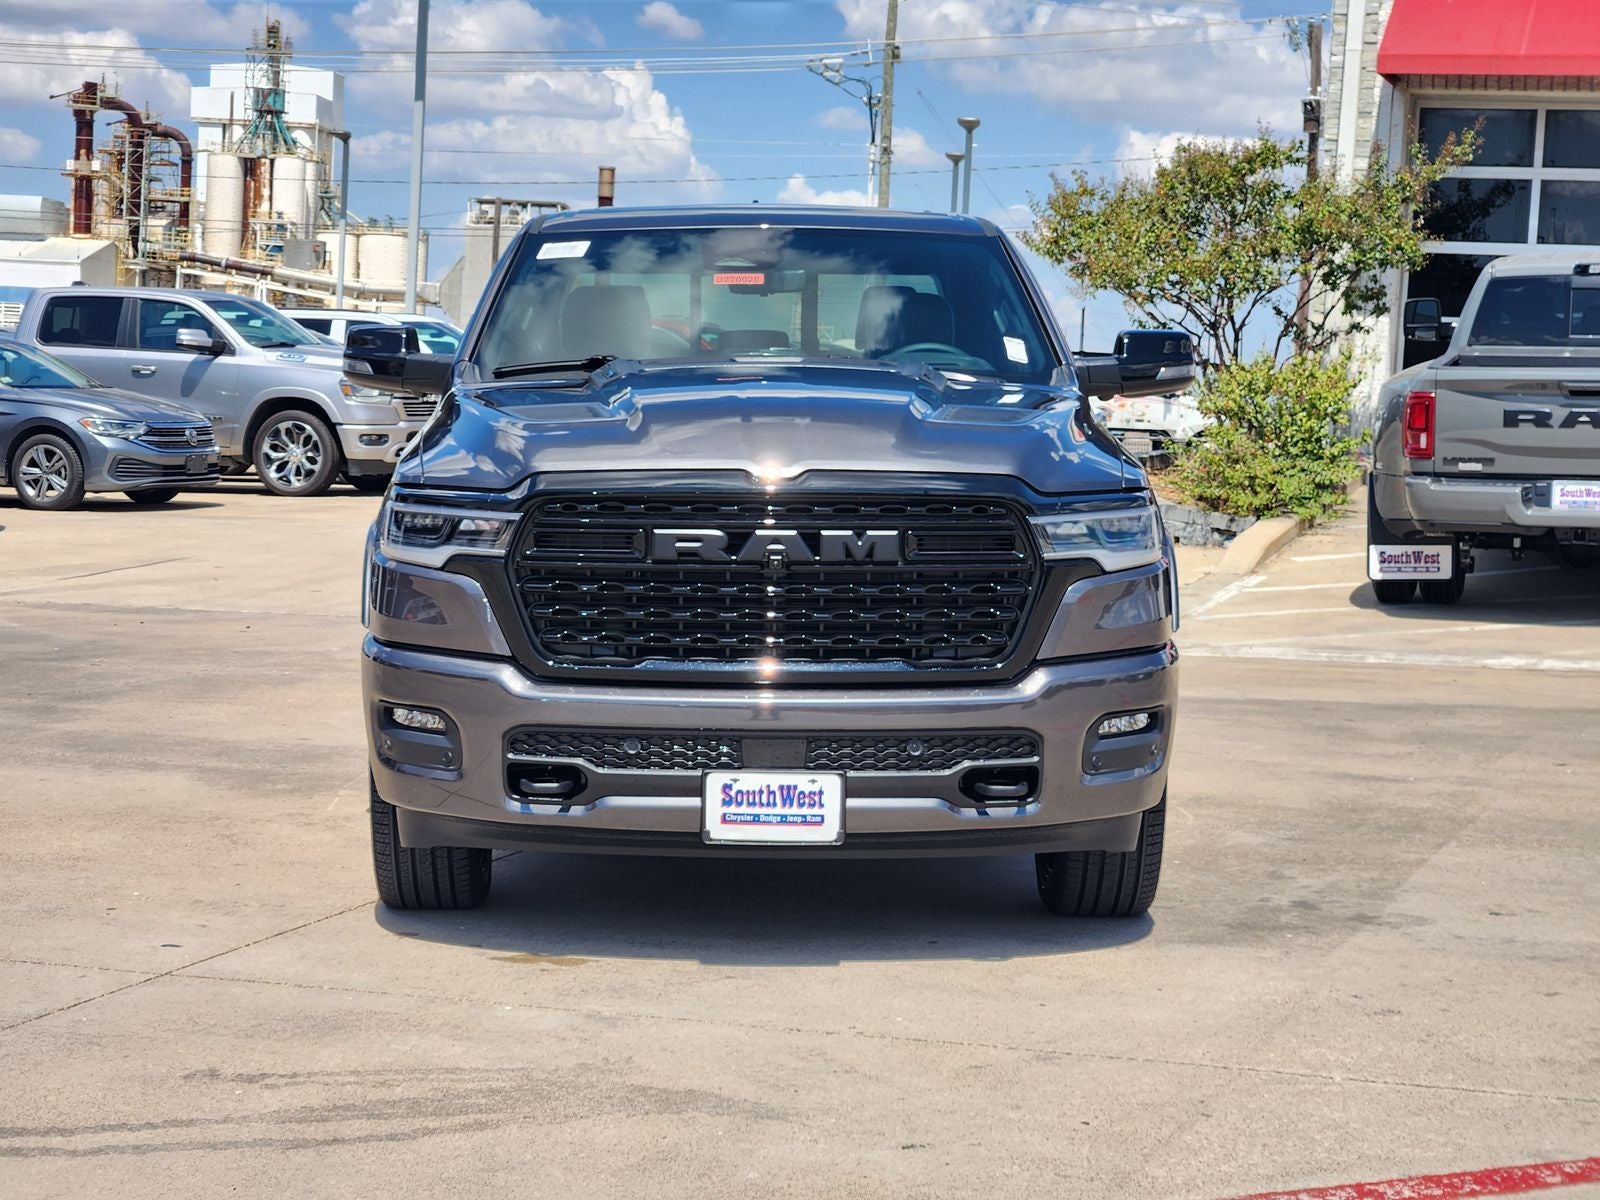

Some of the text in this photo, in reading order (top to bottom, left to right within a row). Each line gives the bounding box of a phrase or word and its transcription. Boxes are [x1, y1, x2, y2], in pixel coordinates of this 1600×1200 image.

[1503, 408, 1600, 428] RA
[652, 528, 899, 561] RAM
[720, 782, 825, 808] SouthWest
[725, 814, 754, 822] Chrysler
[760, 815, 781, 823] Dodge
[786, 815, 802, 823] Jeep
